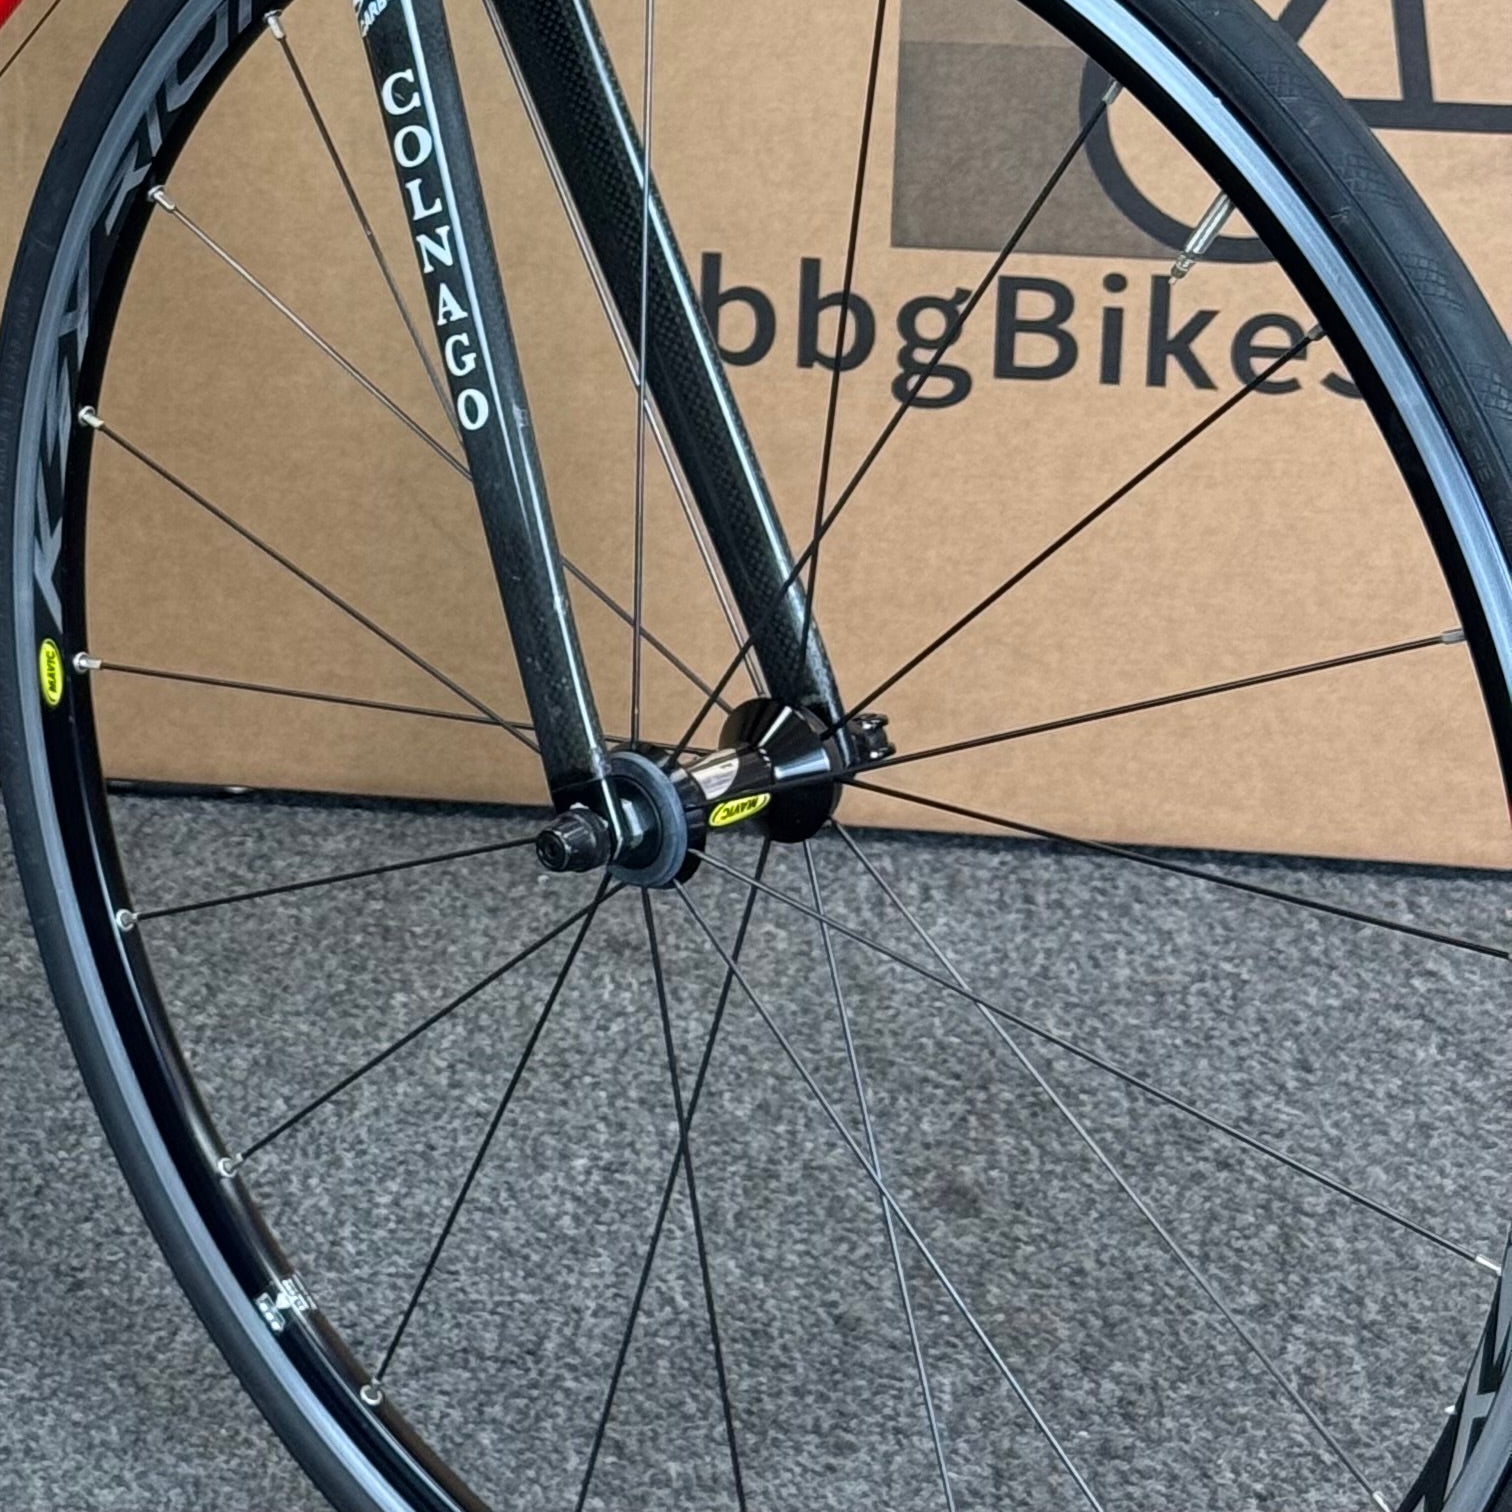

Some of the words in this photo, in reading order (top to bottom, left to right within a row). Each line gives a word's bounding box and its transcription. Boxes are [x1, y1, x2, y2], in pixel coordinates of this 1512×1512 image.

[381, 70, 490, 431] COLNAGO
[45, 649, 58, 694] MAVIC
[719, 796, 760, 821] MAVIC
